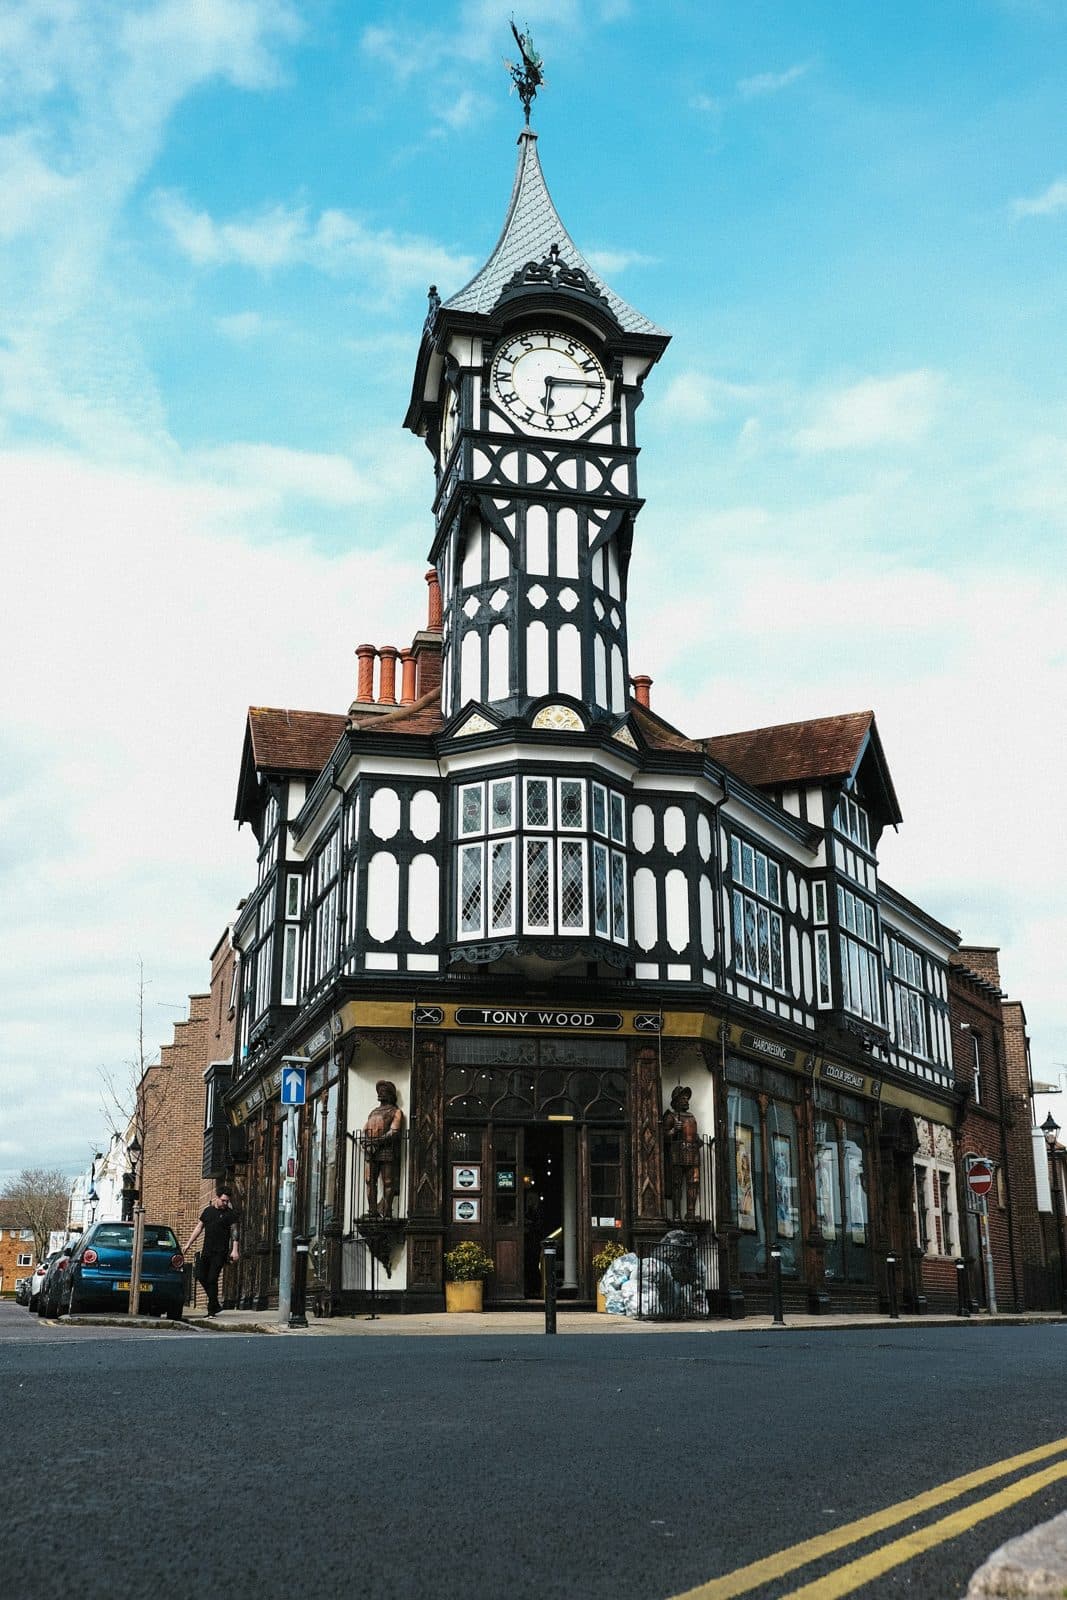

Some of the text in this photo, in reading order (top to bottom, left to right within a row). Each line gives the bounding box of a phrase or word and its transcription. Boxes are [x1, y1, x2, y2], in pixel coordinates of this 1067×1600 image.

[481, 1010, 595, 1026] TONY WOOD
[752, 1037, 787, 1059] HAIRDRESSING
[826, 1065, 844, 1081] COLOUR
